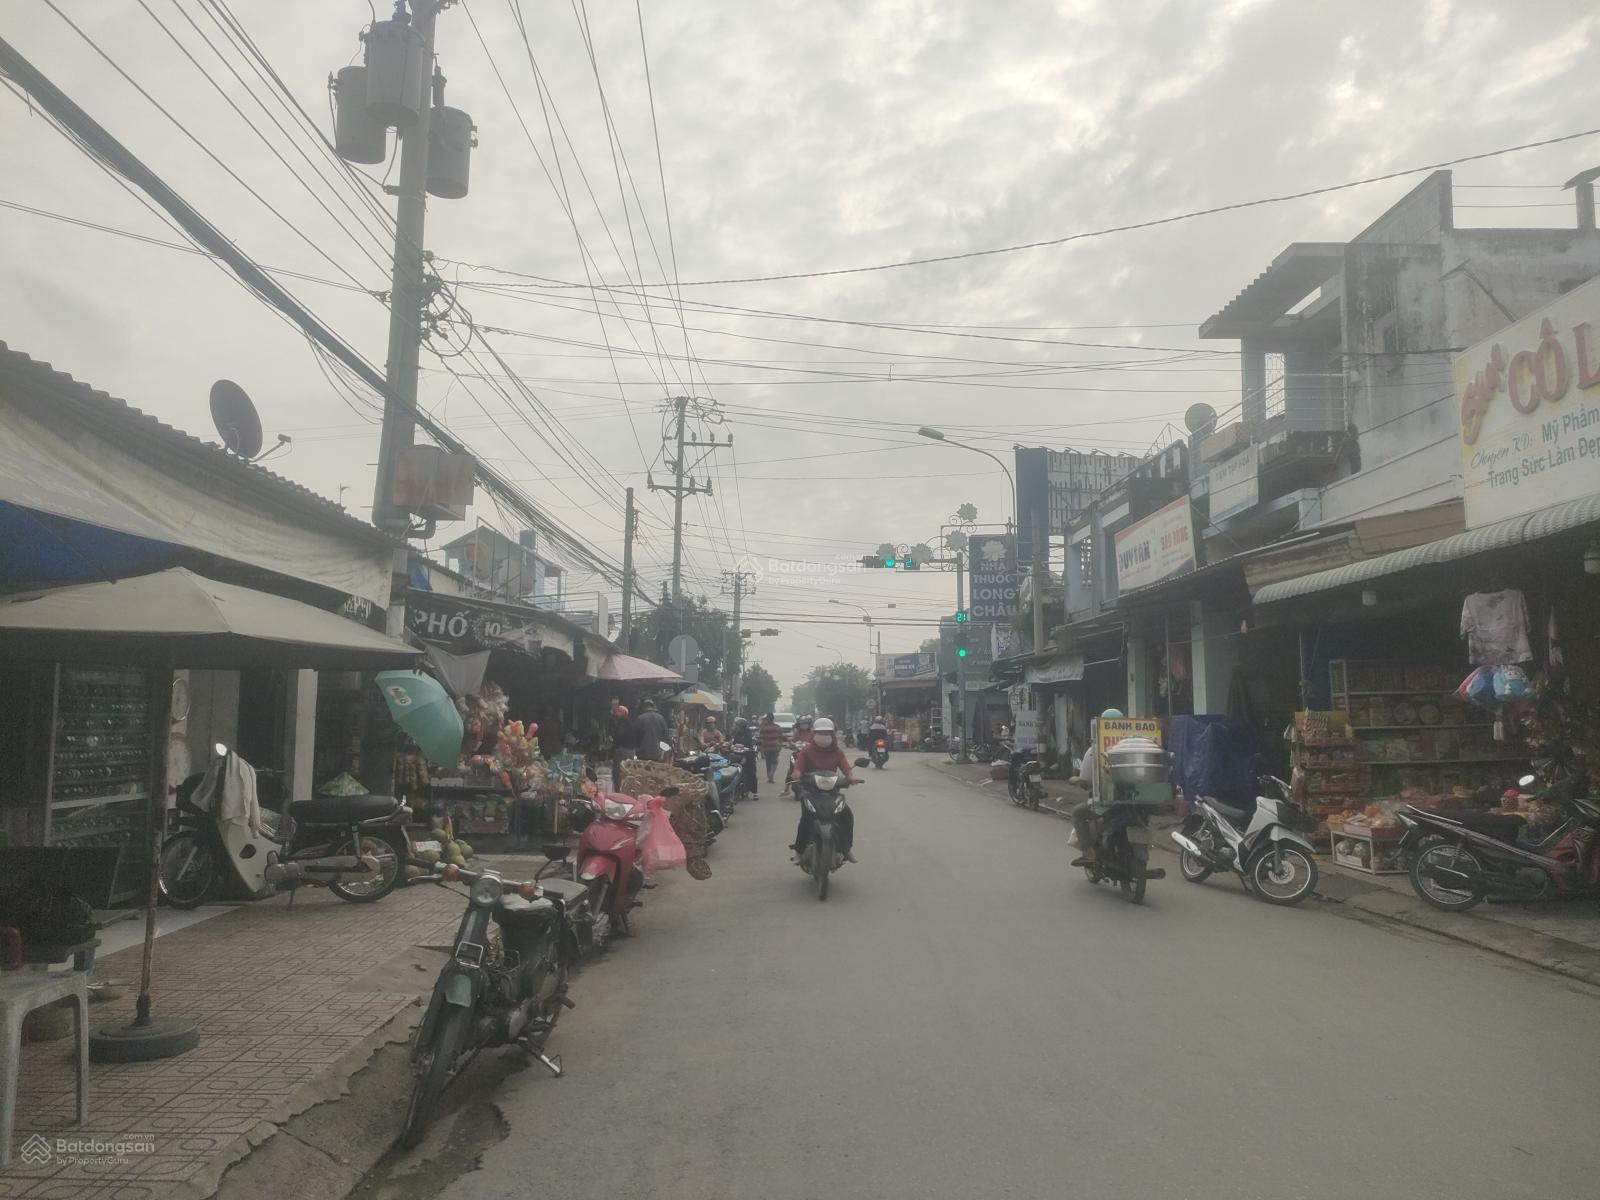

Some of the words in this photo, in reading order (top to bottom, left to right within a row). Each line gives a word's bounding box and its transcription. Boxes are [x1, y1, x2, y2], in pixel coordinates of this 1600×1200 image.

[1542, 419, 1560, 444] Mỹ
[1488, 465, 1520, 488] Trang
[1521, 455, 1546, 477] Sức
[1547, 444, 1576, 468] Làm
[973, 588, 1016, 600] LONG
[973, 602, 1017, 617] CHÂU
